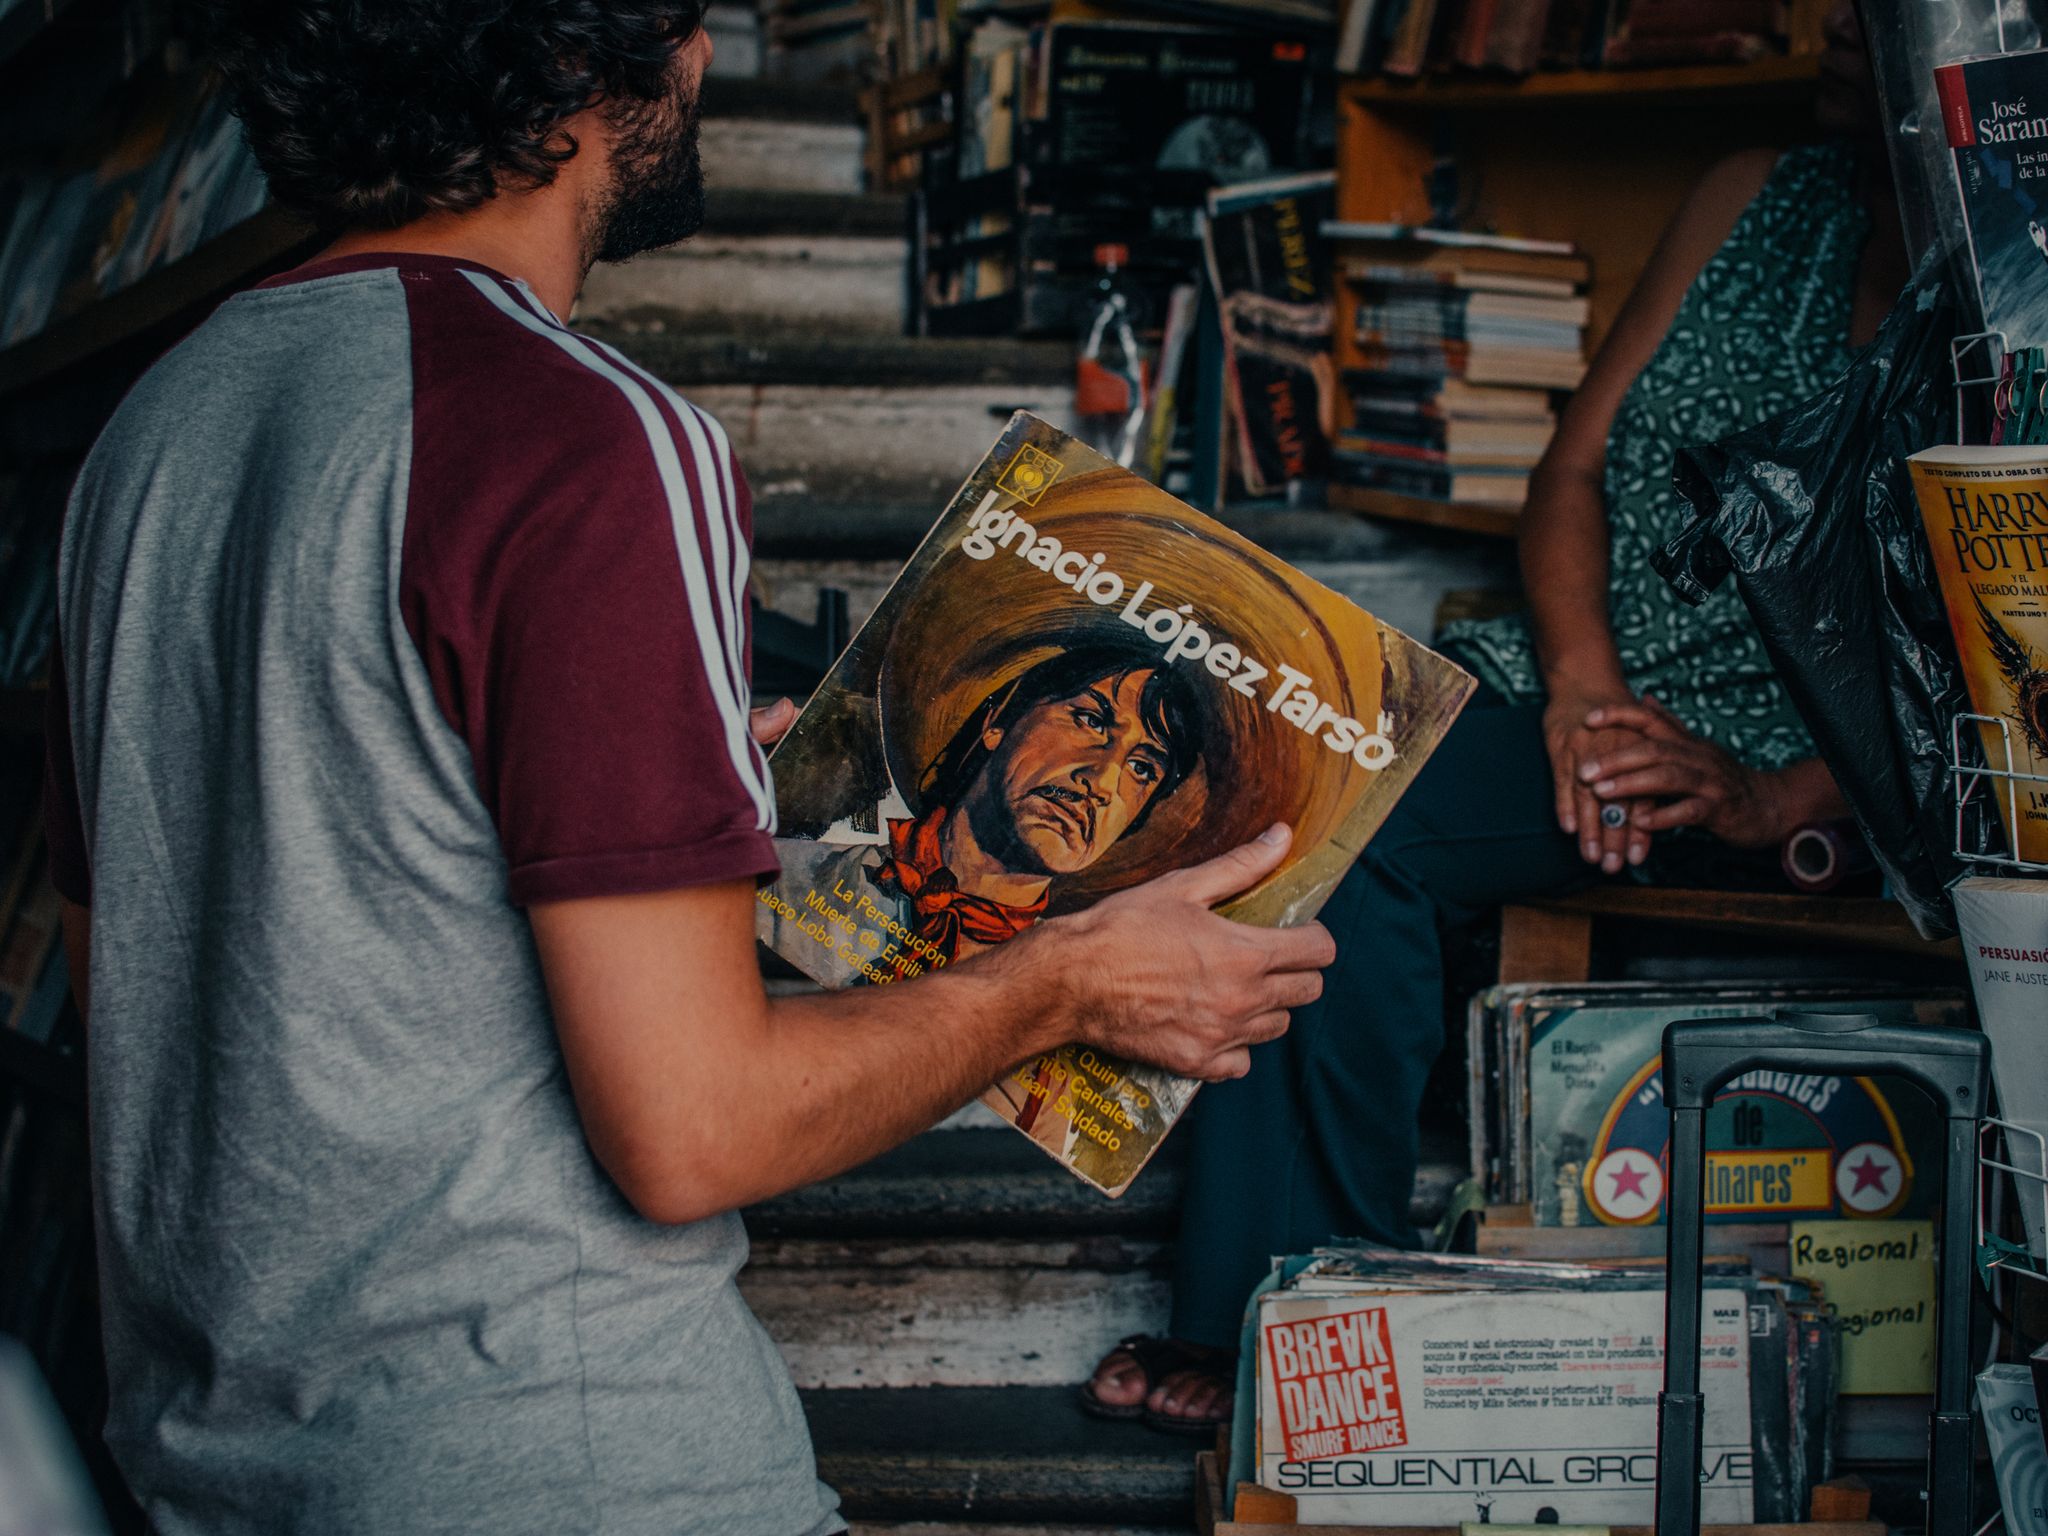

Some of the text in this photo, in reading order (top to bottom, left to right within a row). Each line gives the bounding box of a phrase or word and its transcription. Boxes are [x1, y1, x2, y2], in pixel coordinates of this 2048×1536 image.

[1991, 96, 2027, 123] José
[2016, 153, 2035, 165] Las
[2019, 166, 2046, 179] de la
[1023, 448, 1056, 474] CBS
[1924, 468, 1943, 477] TEXTO
[1944, 469, 1980, 478] COMPLETO
[1982, 470, 1991, 478] DE
[1993, 469, 2003, 477] LA
[2006, 468, 2028, 476] OBRA
[2031, 467, 2041, 475] DE
[1976, 583, 2019, 597] LEGADO
[2012, 575, 2029, 583] Y EL
[2002, 610, 2025, 618] PARTES
[2026, 610, 2041, 618] UNO
[961, 489, 1395, 771] Ignacio López Tarso
[756, 890, 796, 921] uaco
[796, 912, 835, 948] Lobo
[833, 879, 947, 968] La Persecución
[804, 889, 925, 978] Muerte de Emili
[1984, 968, 2011, 983] JANE
[1012, 1066, 1121, 1151] Juan Soldado
[1070, 1076, 1134, 1131] Canales
[1732, 1099, 1764, 1147] de
[1795, 1232, 1919, 1269] Regional
[1713, 1309, 1741, 1318] MAXI
[1271, 1310, 1389, 1380] BREAK
[1473, 1339, 1490, 1350] and
[1494, 1338, 1554, 1350] electronically
[1559, 1338, 1594, 1348] created
[1597, 1337, 1609, 1349] by
[1423, 1350, 1455, 1361] sounds
[1469, 1350, 1500, 1363] special
[1503, 1350, 1533, 1361] effects
[1536, 1349, 1571, 1360] created
[1573, 1350, 1585, 1360] on
[1587, 1348, 1605, 1359] this
[1607, 1348, 1656, 1361] production
[1423, 1363, 1444, 1375] tally
[1446, 1364, 1455, 1374] or
[1457, 1363, 1516, 1376] synthetically
[1281, 1365, 1398, 1434] DANCE
[1423, 1386, 1485, 1399] Co-composed,
[1487, 1386, 1530, 1399] arranged
[1532, 1385, 1549, 1396] and
[1551, 1385, 1598, 1398] performed
[1601, 1385, 1614, 1398] by
[1423, 1399, 1466, 1410] Produced
[1468, 1399, 1479, 1411] by
[1482, 1398, 1504, 1409] Mike
[1571, 1397, 1585, 1407] for
[2010, 1406, 2040, 1424] OC
[1289, 1420, 1404, 1460] SMURF DANCE
[1278, 1457, 1554, 1488] SEQUENTIAL
